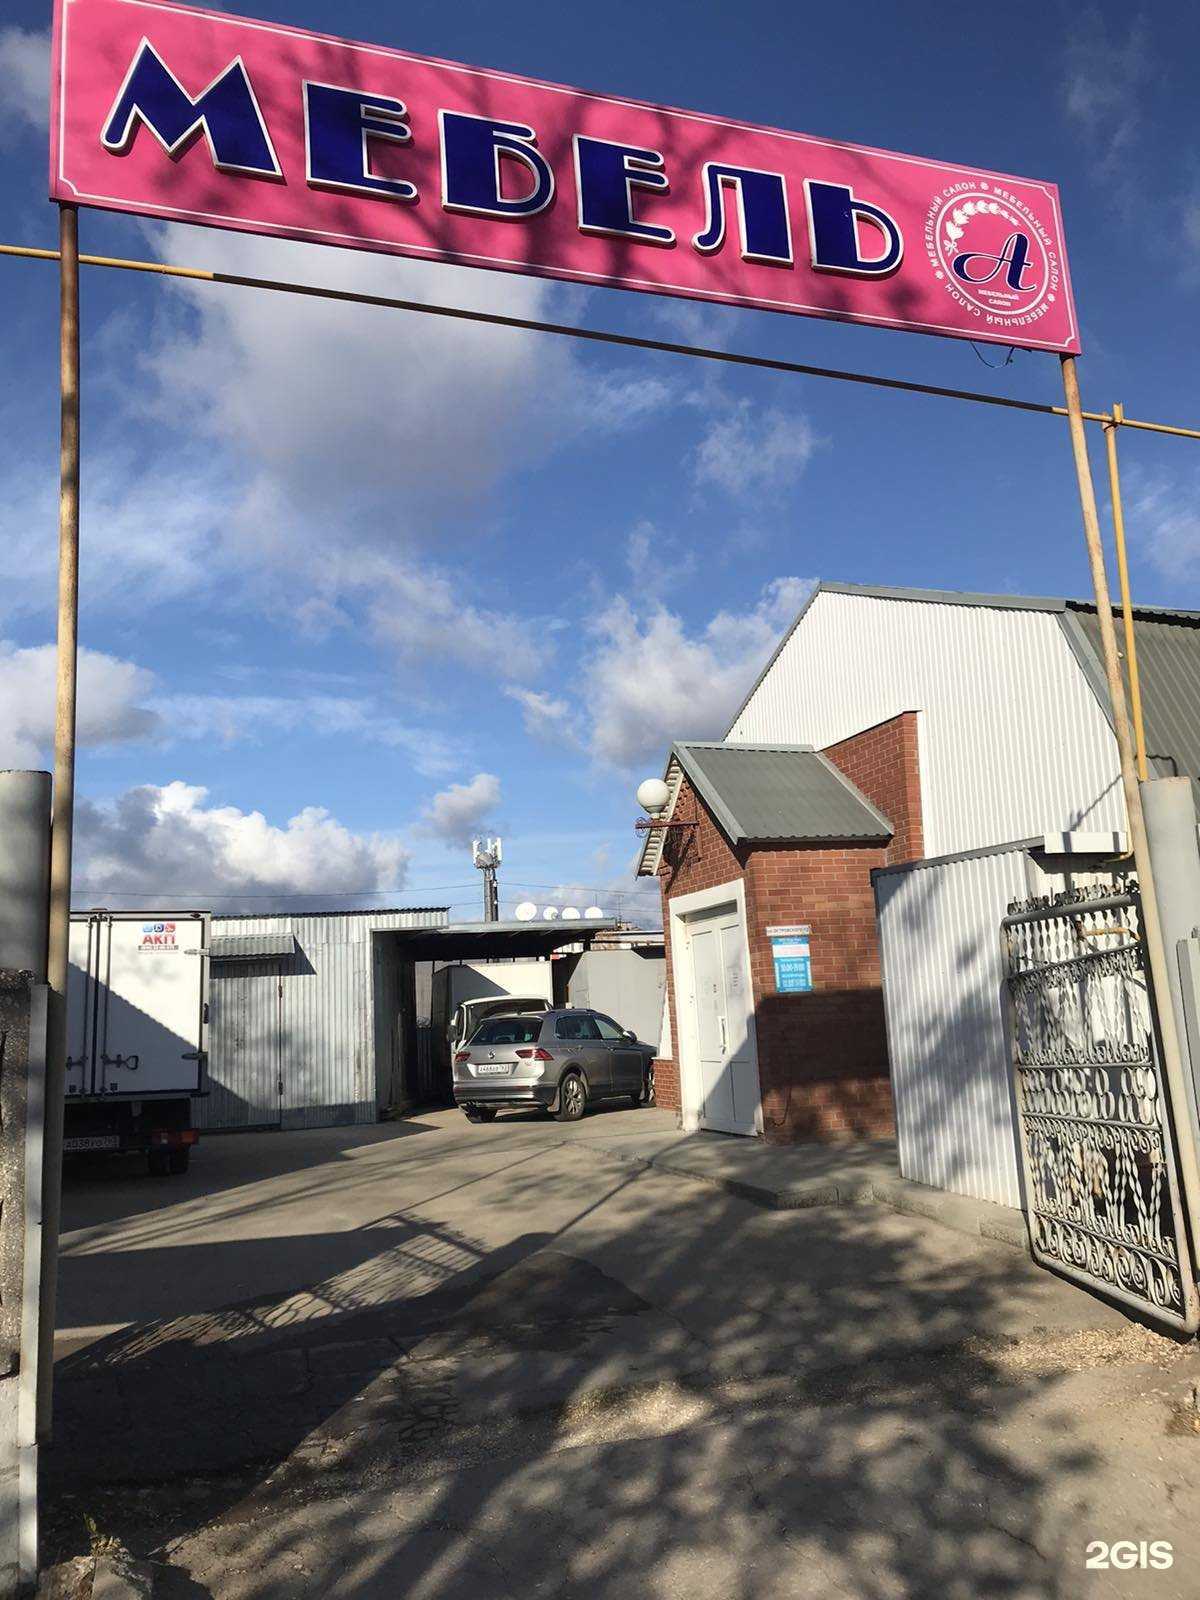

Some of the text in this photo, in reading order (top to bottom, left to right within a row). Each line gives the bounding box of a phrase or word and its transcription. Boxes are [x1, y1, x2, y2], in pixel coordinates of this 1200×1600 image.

[101, 35, 905, 276] МЕБЕЛЬ
[924, 181, 977, 269] МЕБЕЛЬНЫЙ САЛОН
[993, 186, 1059, 292] МЕБЕЛЬНЫЙ САЛОН
[944, 283, 1050, 327] МЕБЕЛЬНЫЙ САЛОН
